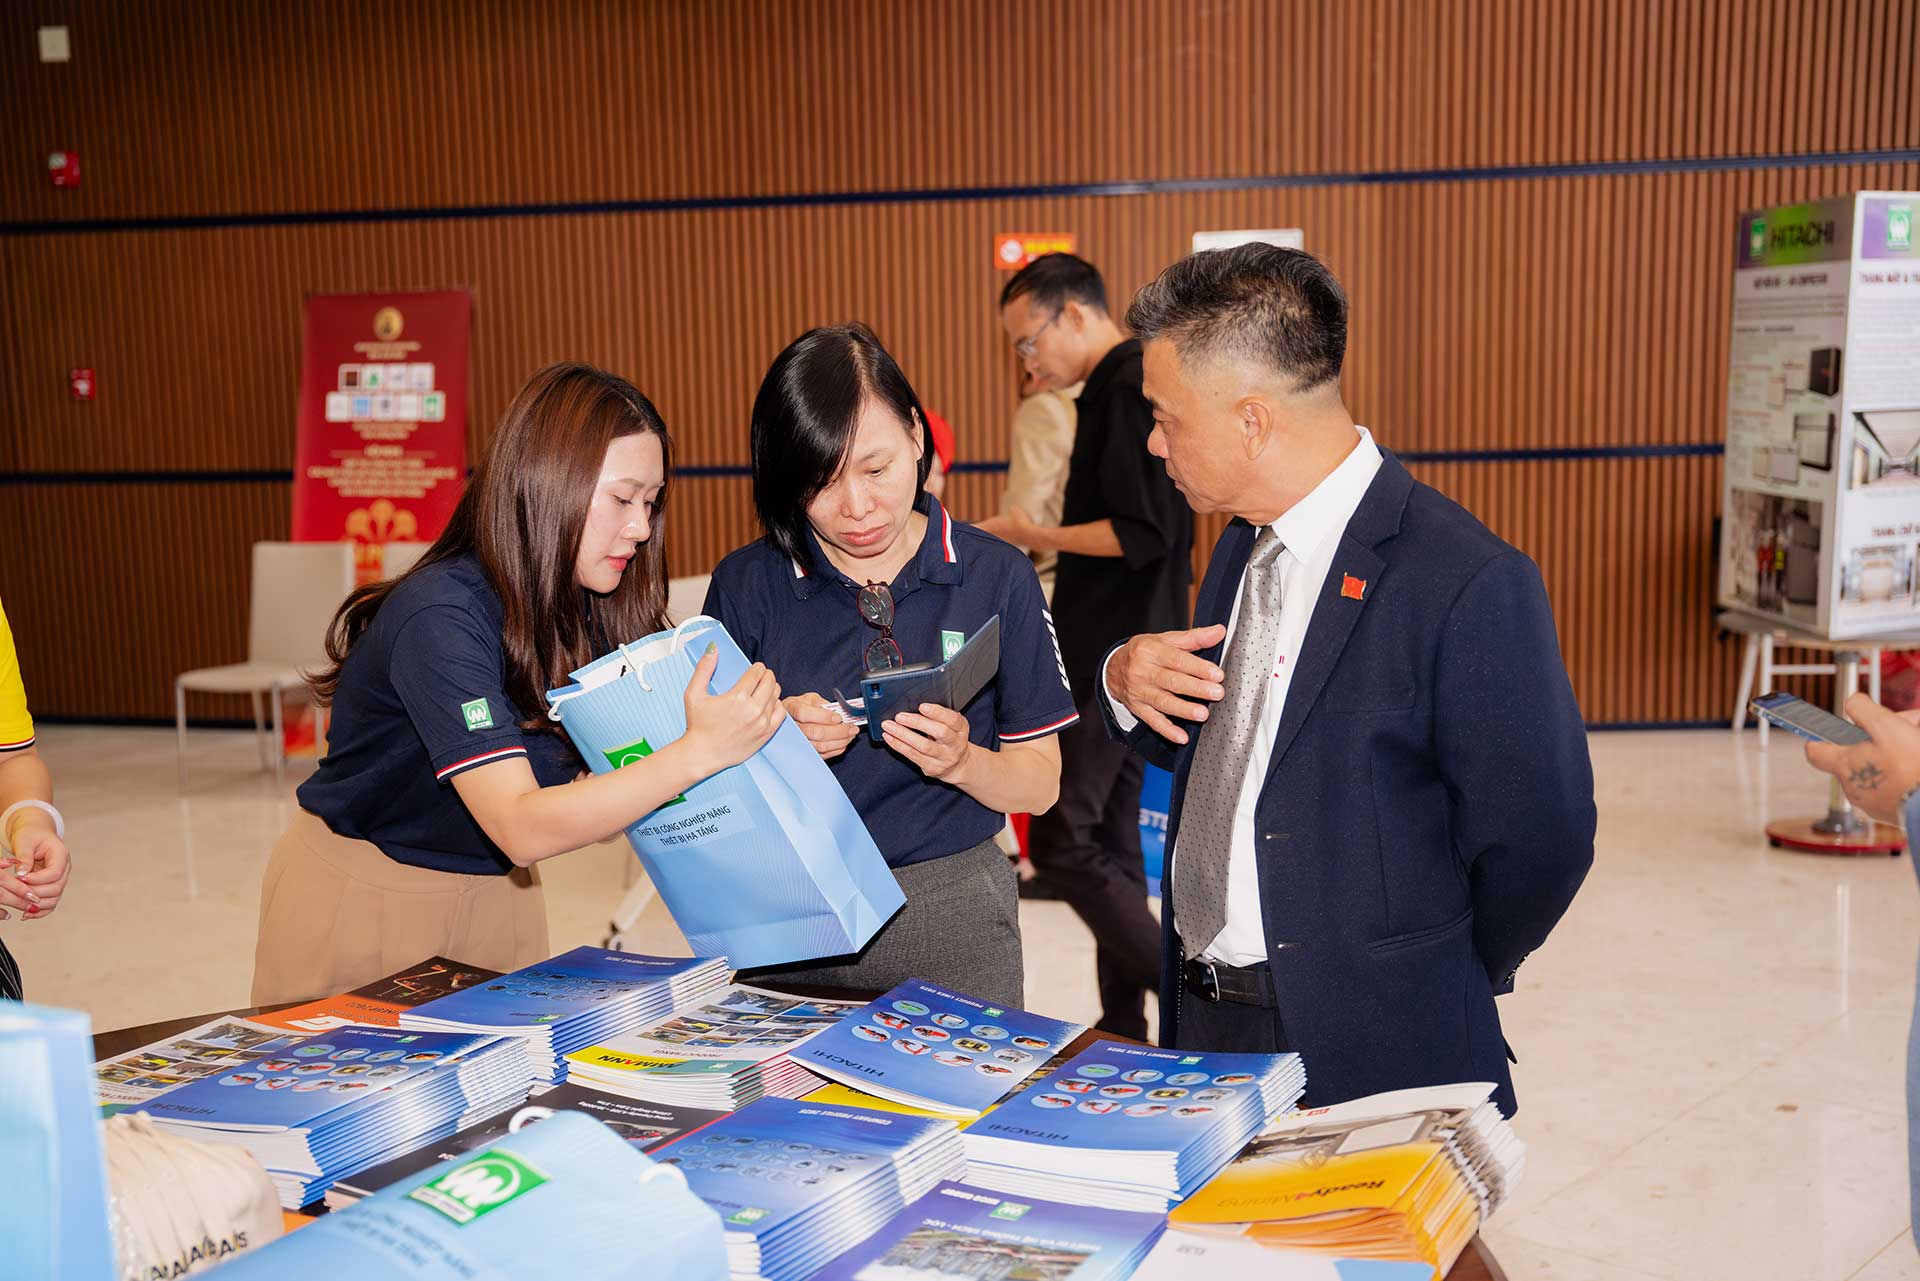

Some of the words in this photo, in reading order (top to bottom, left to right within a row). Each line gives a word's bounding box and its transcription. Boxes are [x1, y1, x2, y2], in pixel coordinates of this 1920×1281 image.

[1771, 220, 1835, 249] HITACHI
[637, 826, 654, 837] THIẾT
[660, 822, 680, 834] CÔNG
[678, 812, 706, 830] NGHIỆP
[706, 804, 731, 820] NẶNG
[660, 834, 679, 846] THIẾT
[677, 833, 688, 844] BỊ
[686, 831, 699, 842] HẠ
[697, 824, 719, 837] TẦNG
[936, 991, 955, 1000] LINES
[954, 996, 984, 1009] PRODUCT
[598, 1055, 683, 1069] AMMANN
[813, 1050, 885, 1078] HITACHI
[146, 1102, 217, 1116] HITACHI
[822, 1110, 854, 1119] PROFILE
[853, 1114, 893, 1125] COMPANY
[988, 1123, 1070, 1141] HITACHI
[1218, 1179, 1385, 1207] Ready4Mining
